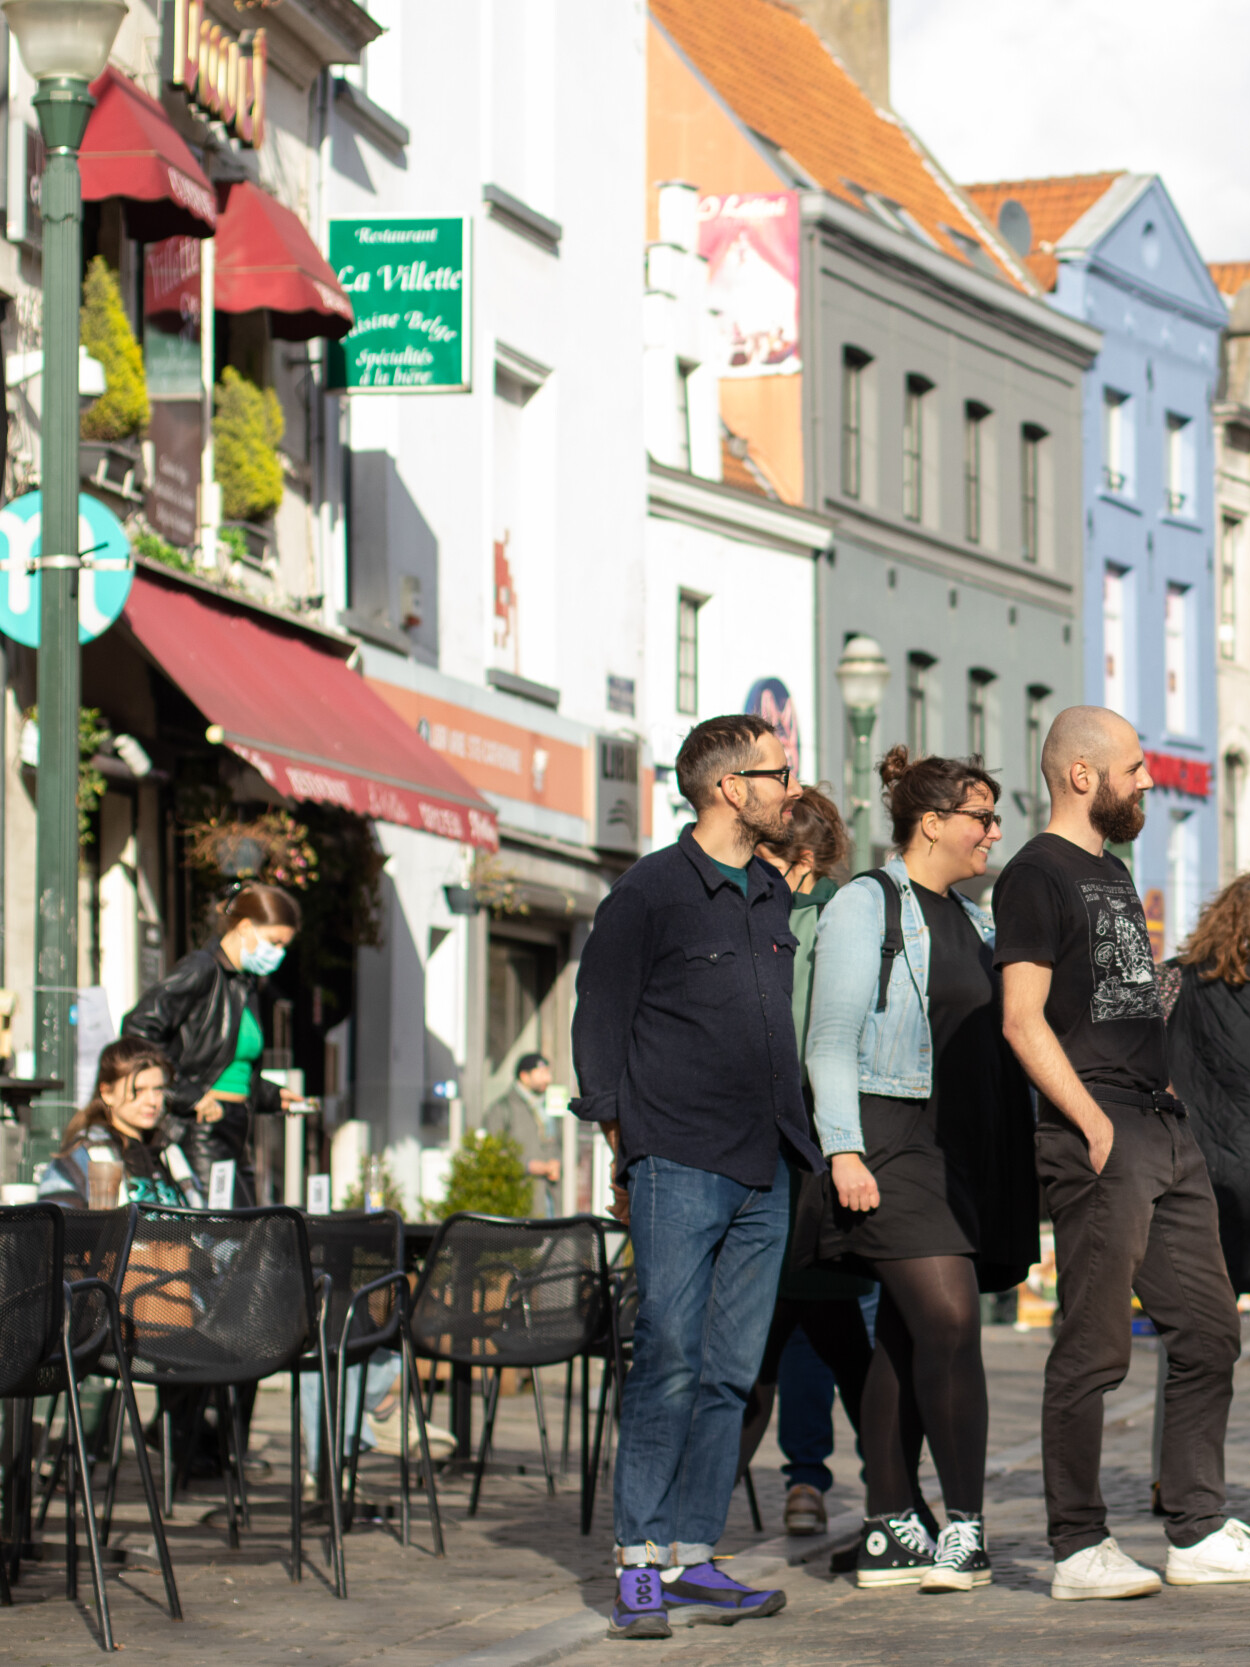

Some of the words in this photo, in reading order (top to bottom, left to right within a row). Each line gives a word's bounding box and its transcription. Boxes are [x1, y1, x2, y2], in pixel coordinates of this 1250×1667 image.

[355, 227, 438, 243] Restaurant
[337, 265, 371, 292] La
[377, 261, 463, 292] Villette
[339, 312, 400, 344] uisine
[404, 311, 457, 342] Belge
